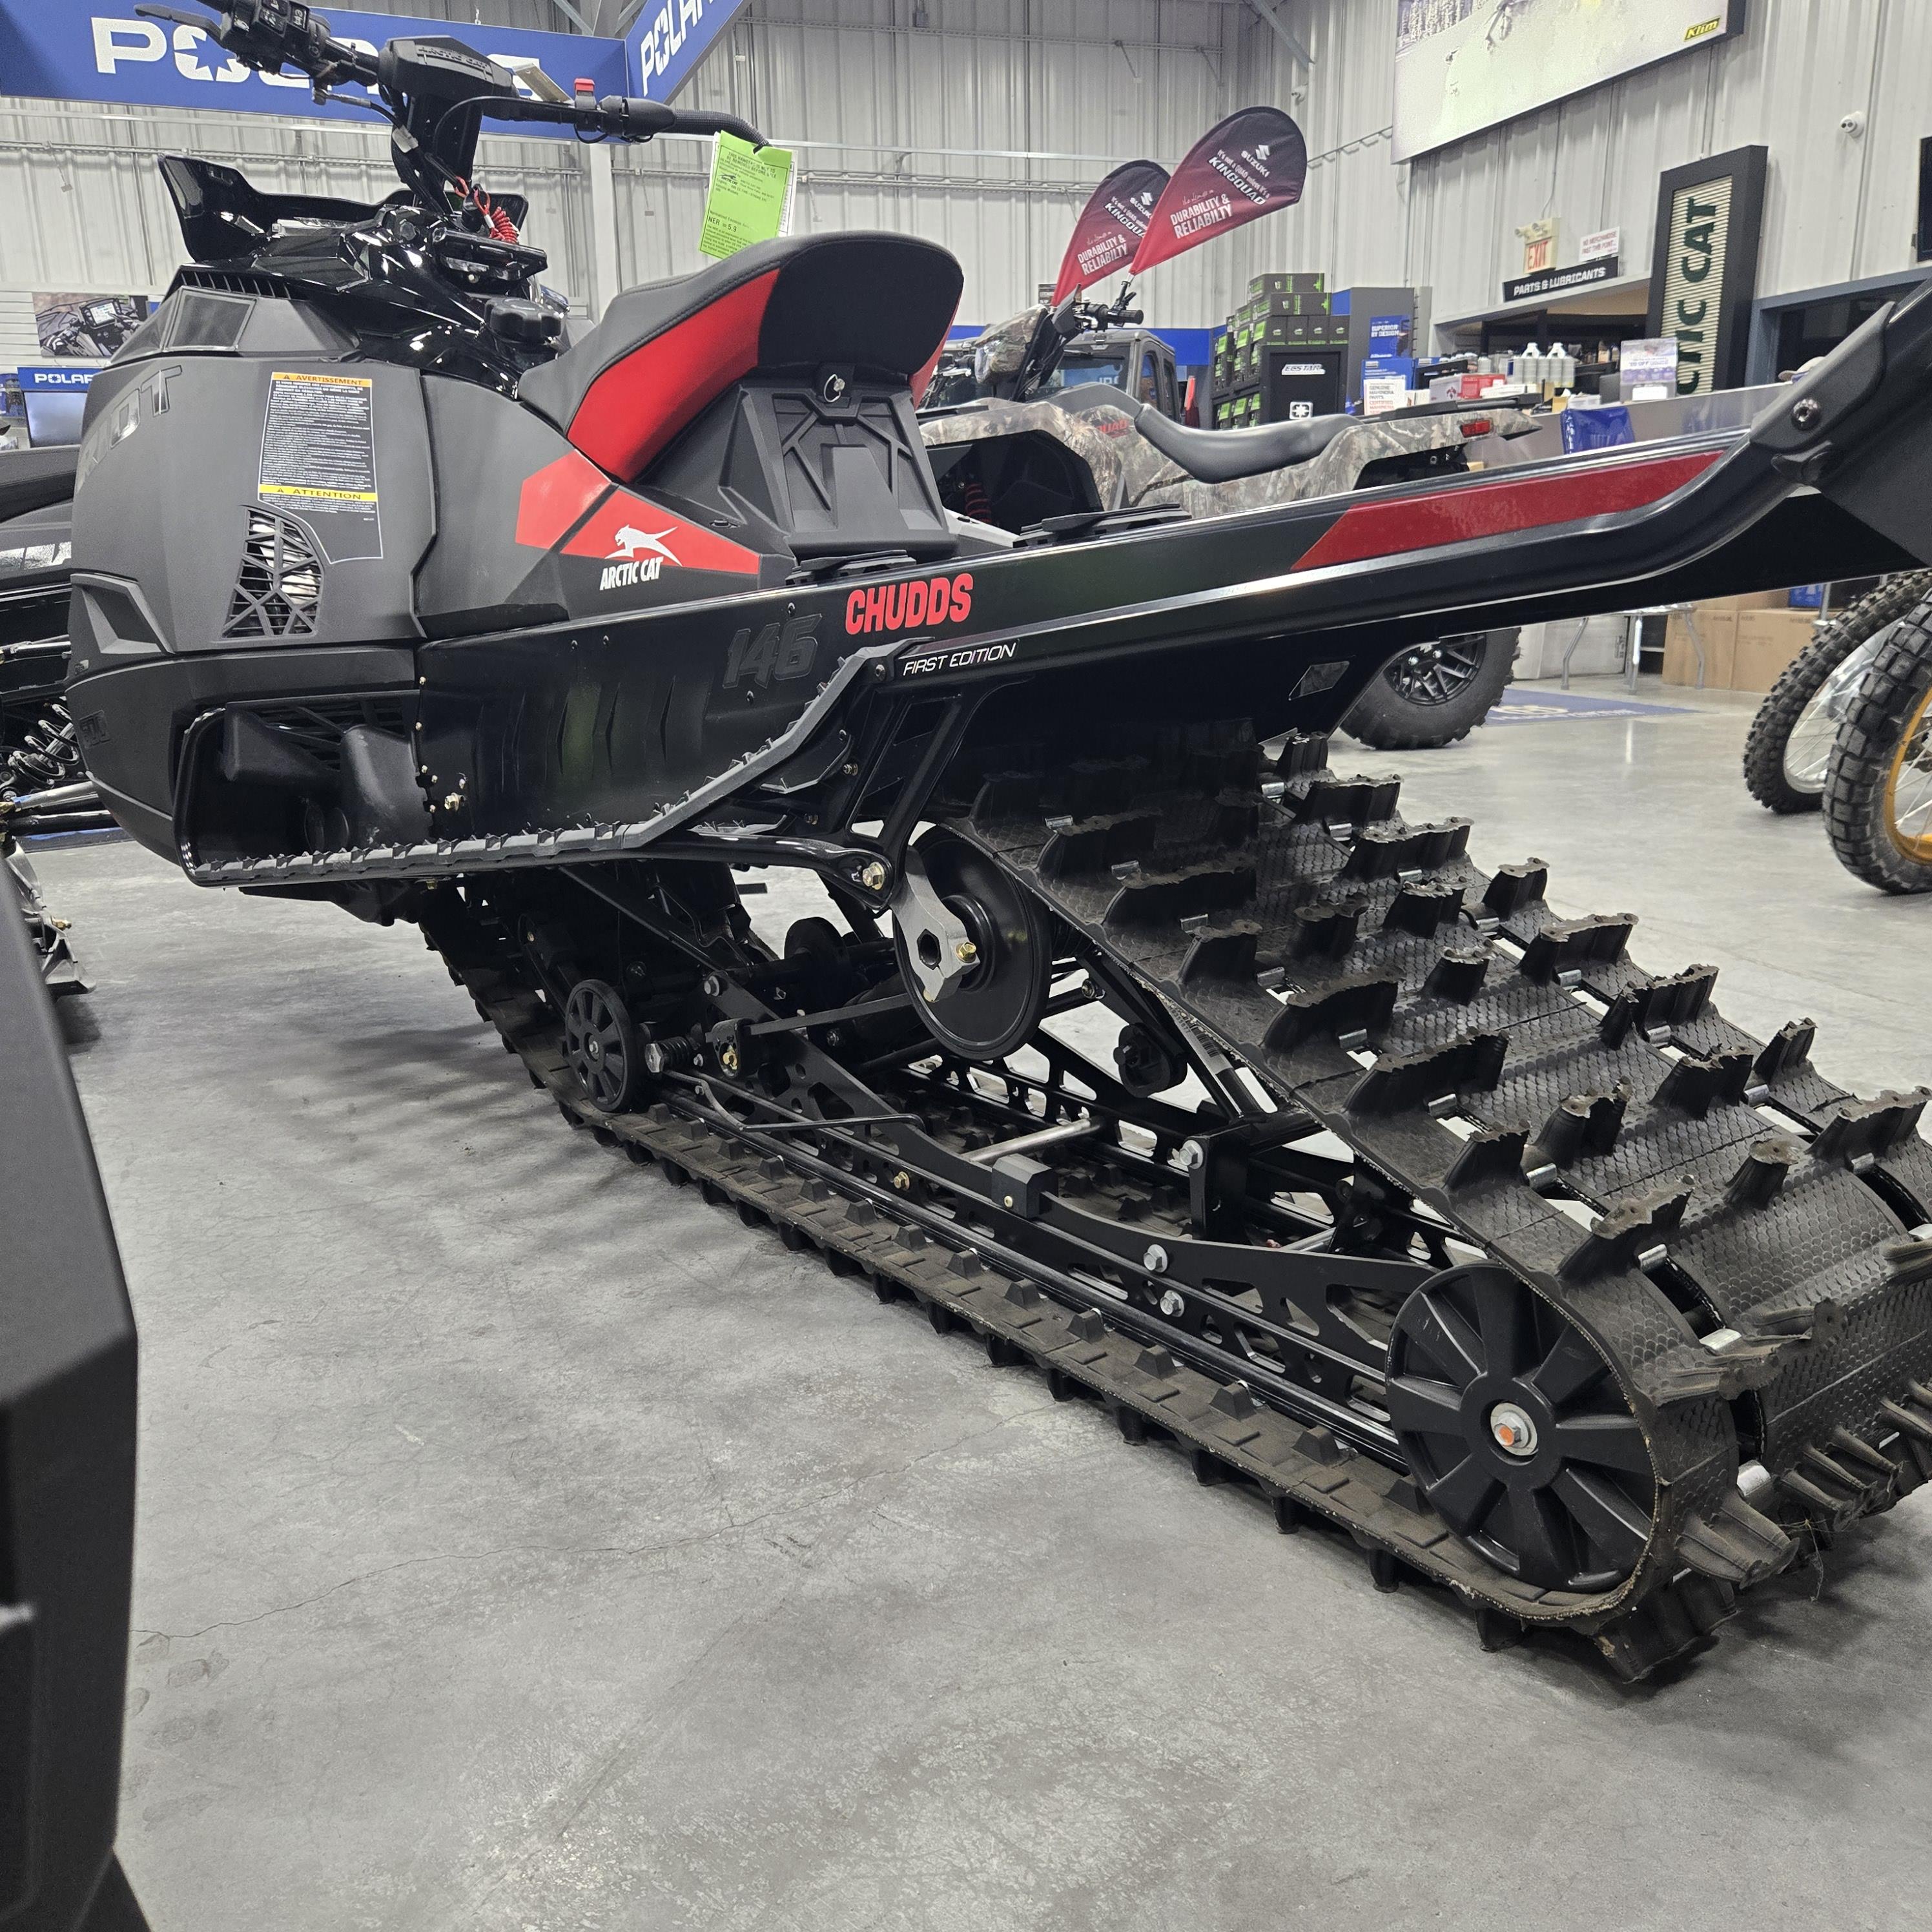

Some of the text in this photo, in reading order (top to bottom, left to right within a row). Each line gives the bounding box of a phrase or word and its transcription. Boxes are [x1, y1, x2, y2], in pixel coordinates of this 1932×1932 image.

[641, 0, 714, 97] POLA
[1234, 164, 1249, 178] QUAD
[1240, 149, 1270, 178] SUZUKI
[1208, 157, 1266, 205] KINGQUAD
[708, 216, 720, 225] NER
[728, 223, 737, 232] 5.9
[1104, 202, 1146, 238] KINGQUA
[1130, 196, 1152, 219] SUZUK
[1170, 193, 1231, 226] DURABILITY &
[1173, 203, 1233, 240] RELIABILTY
[1078, 236, 1118, 264] DURABILITY
[1118, 234, 1126, 243] &
[1528, 240, 1549, 271] EXIT
[1681, 196, 1716, 283] CAT
[1081, 243, 1128, 276] RELIABILTY
[1514, 267, 1607, 296] PARTS & LUBRICANTS
[1675, 299, 1707, 395] CTIC
[34, 373, 94, 384] POLAR
[296, 375, 362, 386] AVERTISSEMENT
[293, 488, 362, 500] ATTENTION
[599, 556, 664, 591] ARCTIC CAT
[845, 572, 974, 635] CHUDDS
[722, 613, 823, 689] 146
[903, 642, 1018, 676] FIRST EDITION
